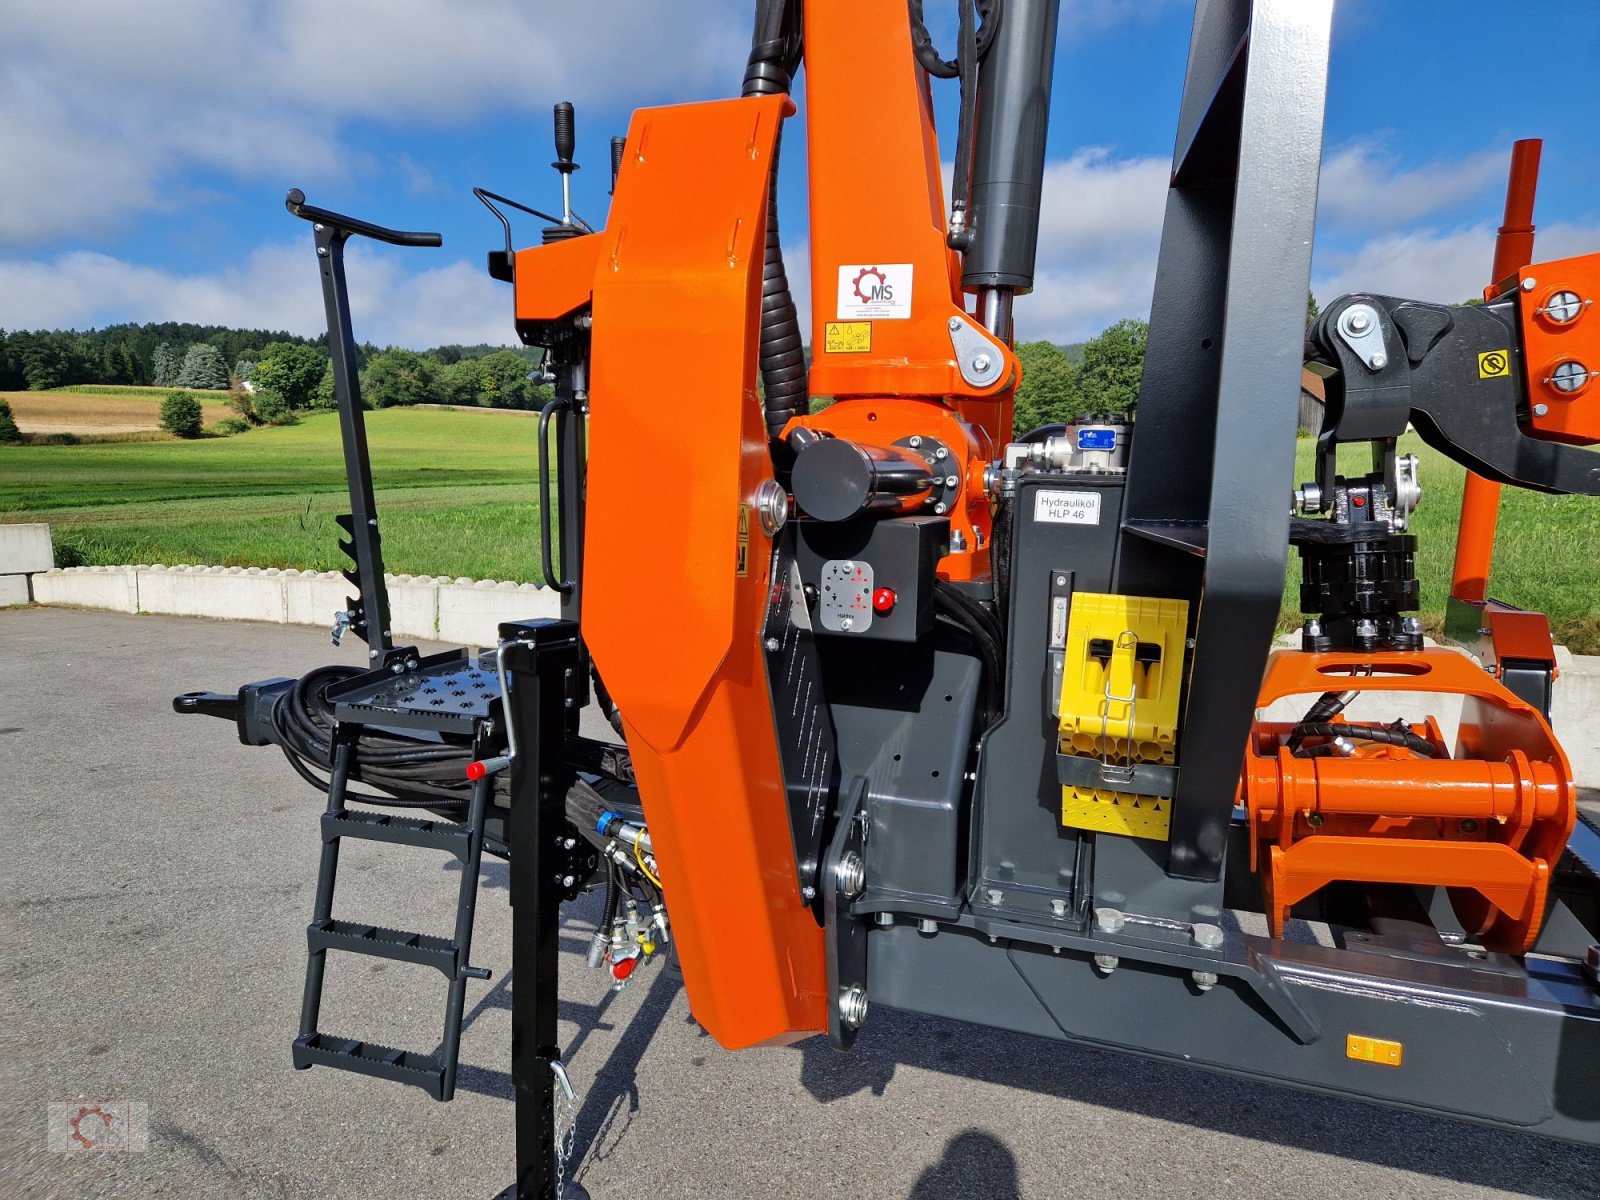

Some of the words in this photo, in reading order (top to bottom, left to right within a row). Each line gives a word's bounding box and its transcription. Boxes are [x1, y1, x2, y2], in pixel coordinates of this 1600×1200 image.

[871, 285, 893, 301] MS
[1041, 496, 1095, 508] Hydrauliköl
[1048, 509, 1070, 518] HLP
[1072, 510, 1085, 519] 46
